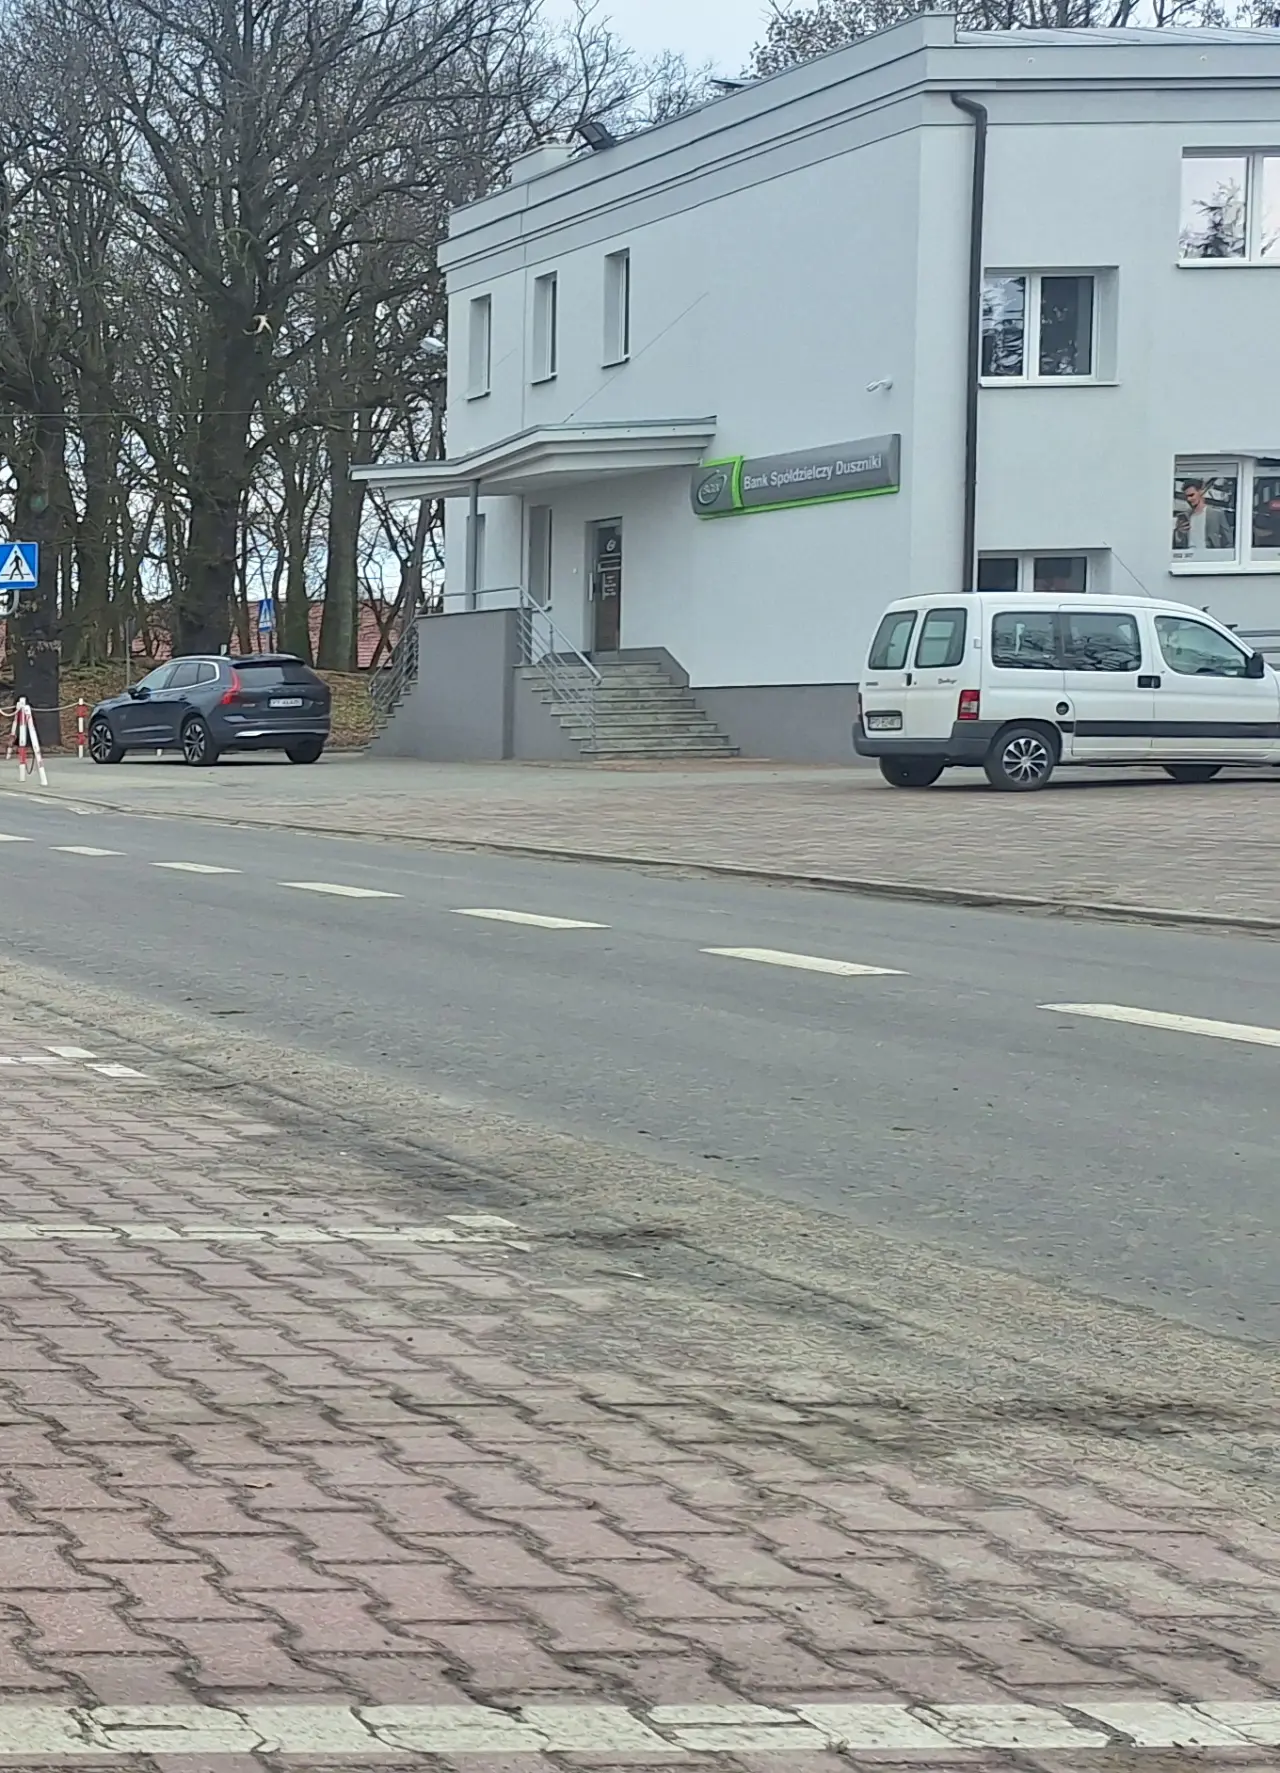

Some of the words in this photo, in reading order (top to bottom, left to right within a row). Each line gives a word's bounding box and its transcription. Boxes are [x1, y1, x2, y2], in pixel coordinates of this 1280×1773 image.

[744, 475, 769, 490] Bank
[770, 465, 833, 487] Spółdzielczy
[835, 454, 882, 475] Duszniki
